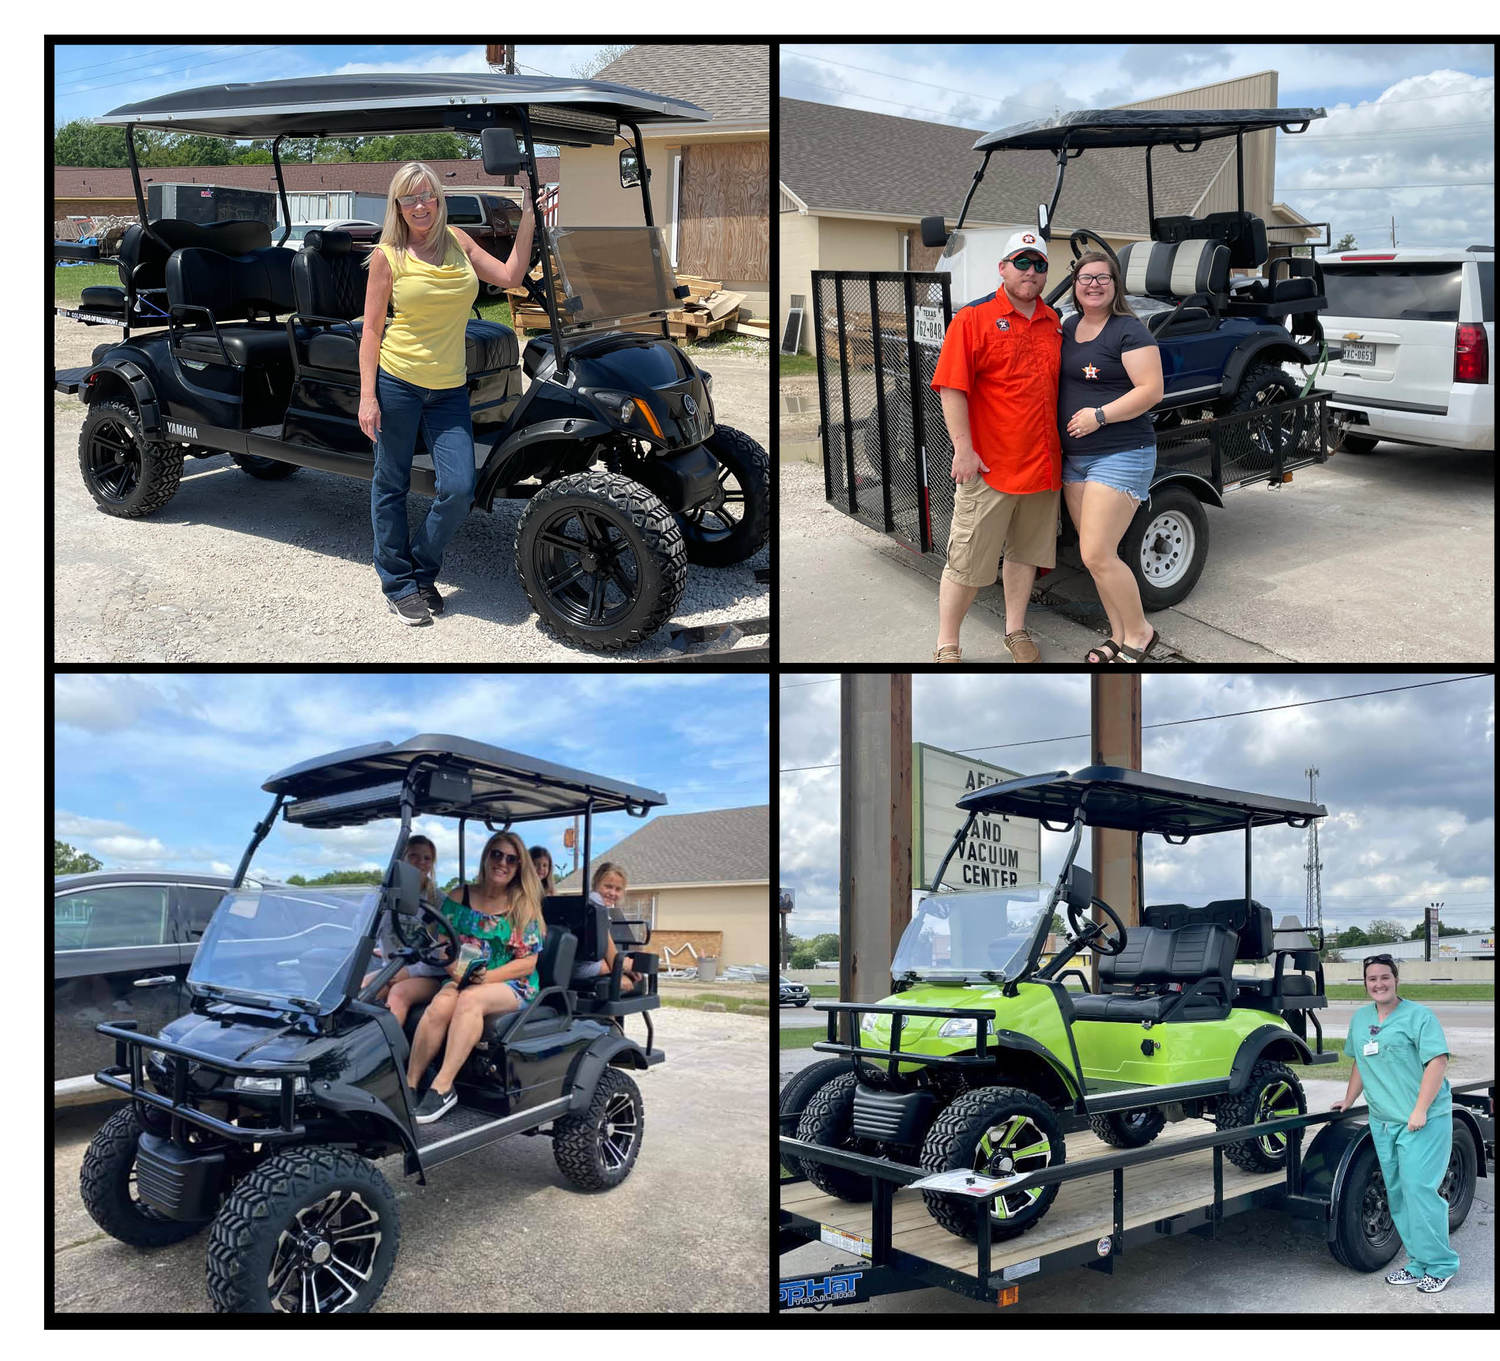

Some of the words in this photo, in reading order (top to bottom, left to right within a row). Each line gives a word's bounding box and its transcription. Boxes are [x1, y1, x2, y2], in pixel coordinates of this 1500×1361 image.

[923, 309, 936, 318] TEXAS
[166, 421, 199, 440] YAMAHA
[970, 818, 1002, 843] AND
[957, 839, 1019, 869] VACUUM
[962, 863, 1018, 889] CENTER
